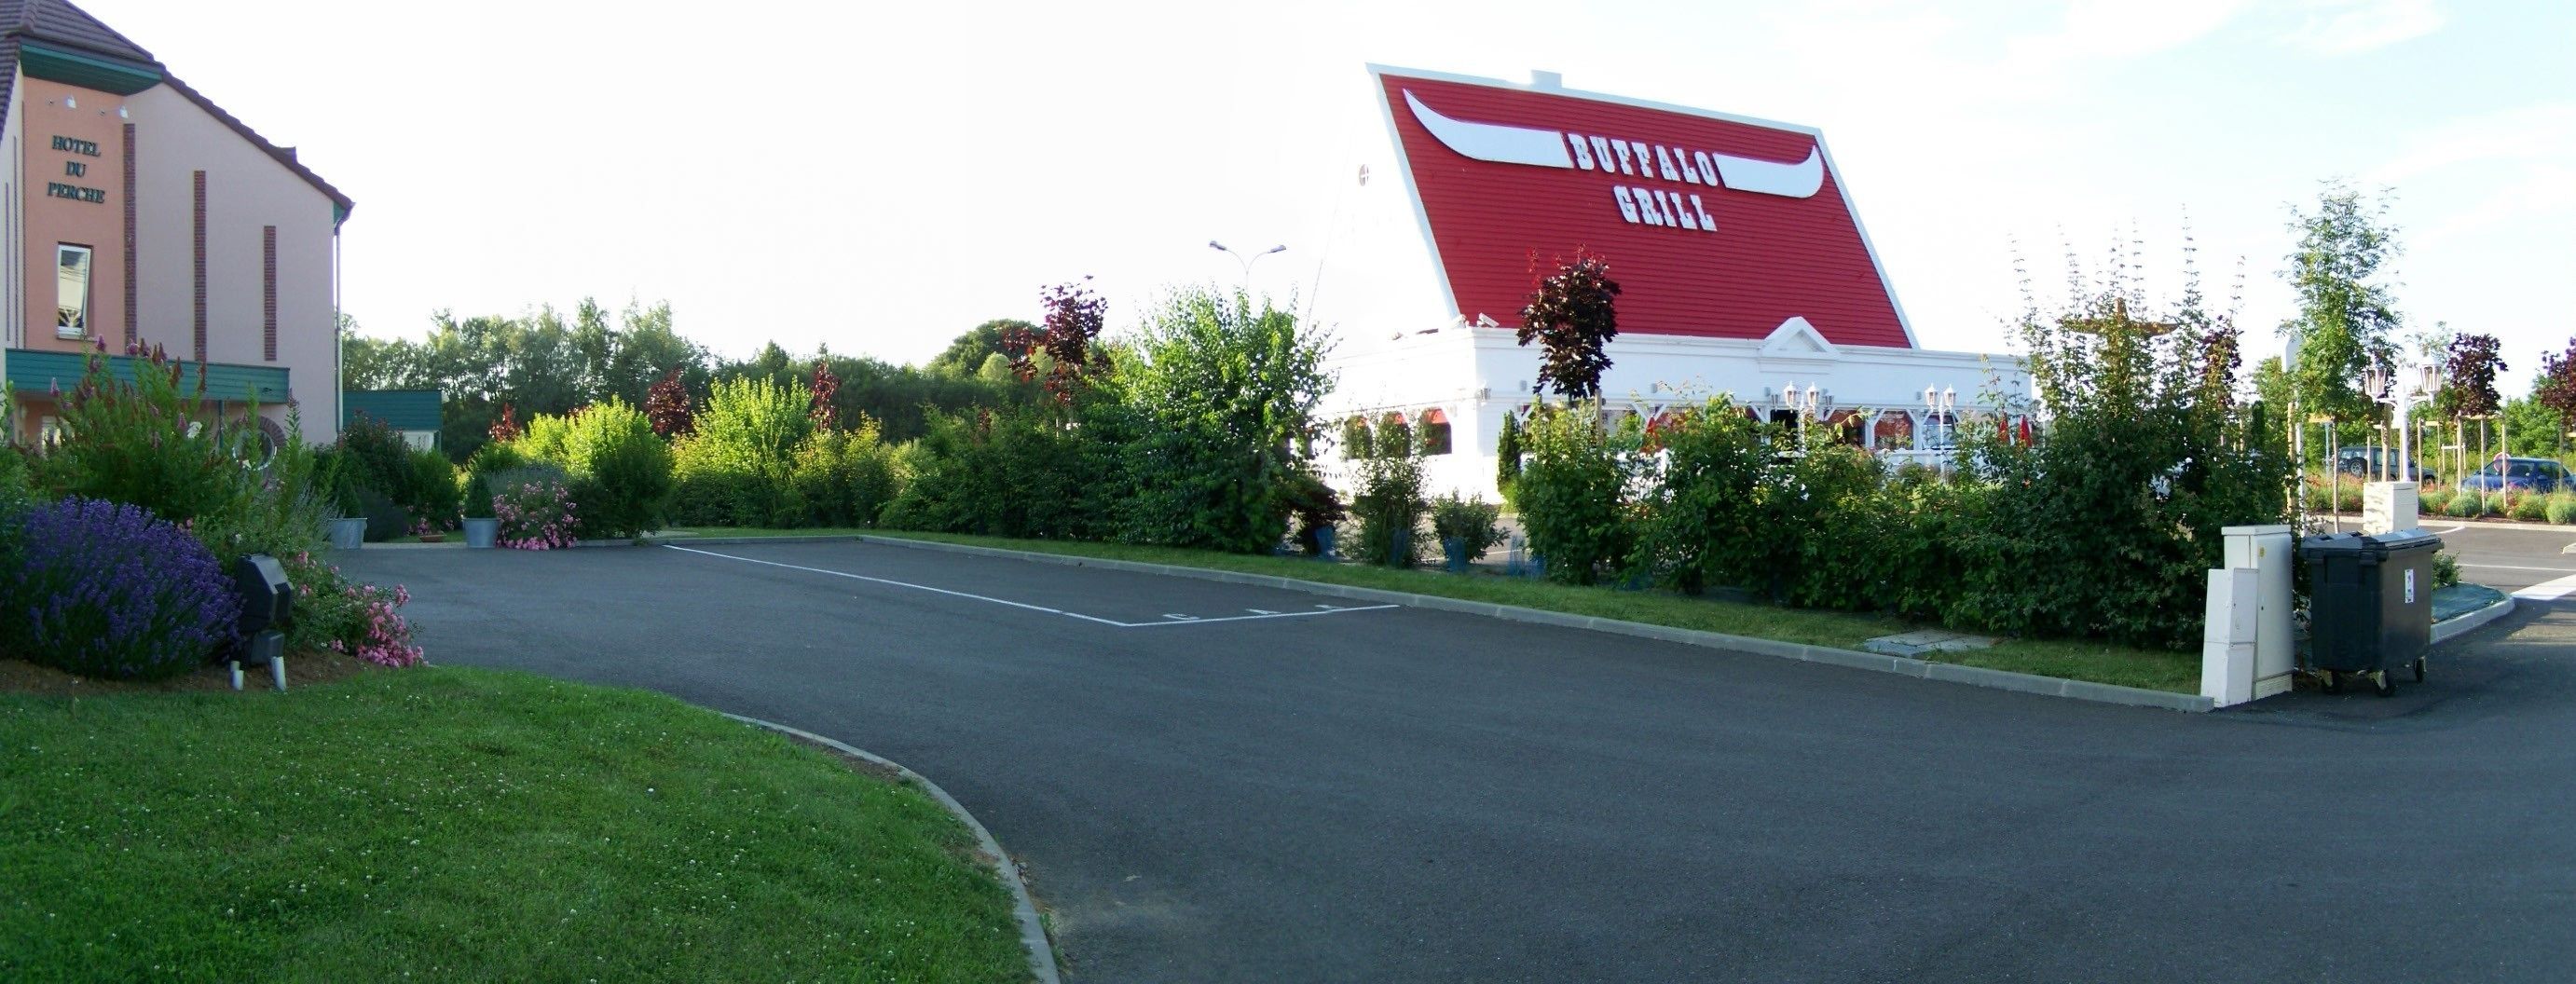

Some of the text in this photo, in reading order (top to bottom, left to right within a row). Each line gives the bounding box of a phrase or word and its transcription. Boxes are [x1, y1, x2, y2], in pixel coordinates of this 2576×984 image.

[52, 135, 101, 157] HOTEL
[66, 161, 86, 177] DU
[1567, 133, 1719, 186] BUFFALO
[48, 182, 105, 203] PERCHE
[1613, 185, 1718, 231] GRILL
